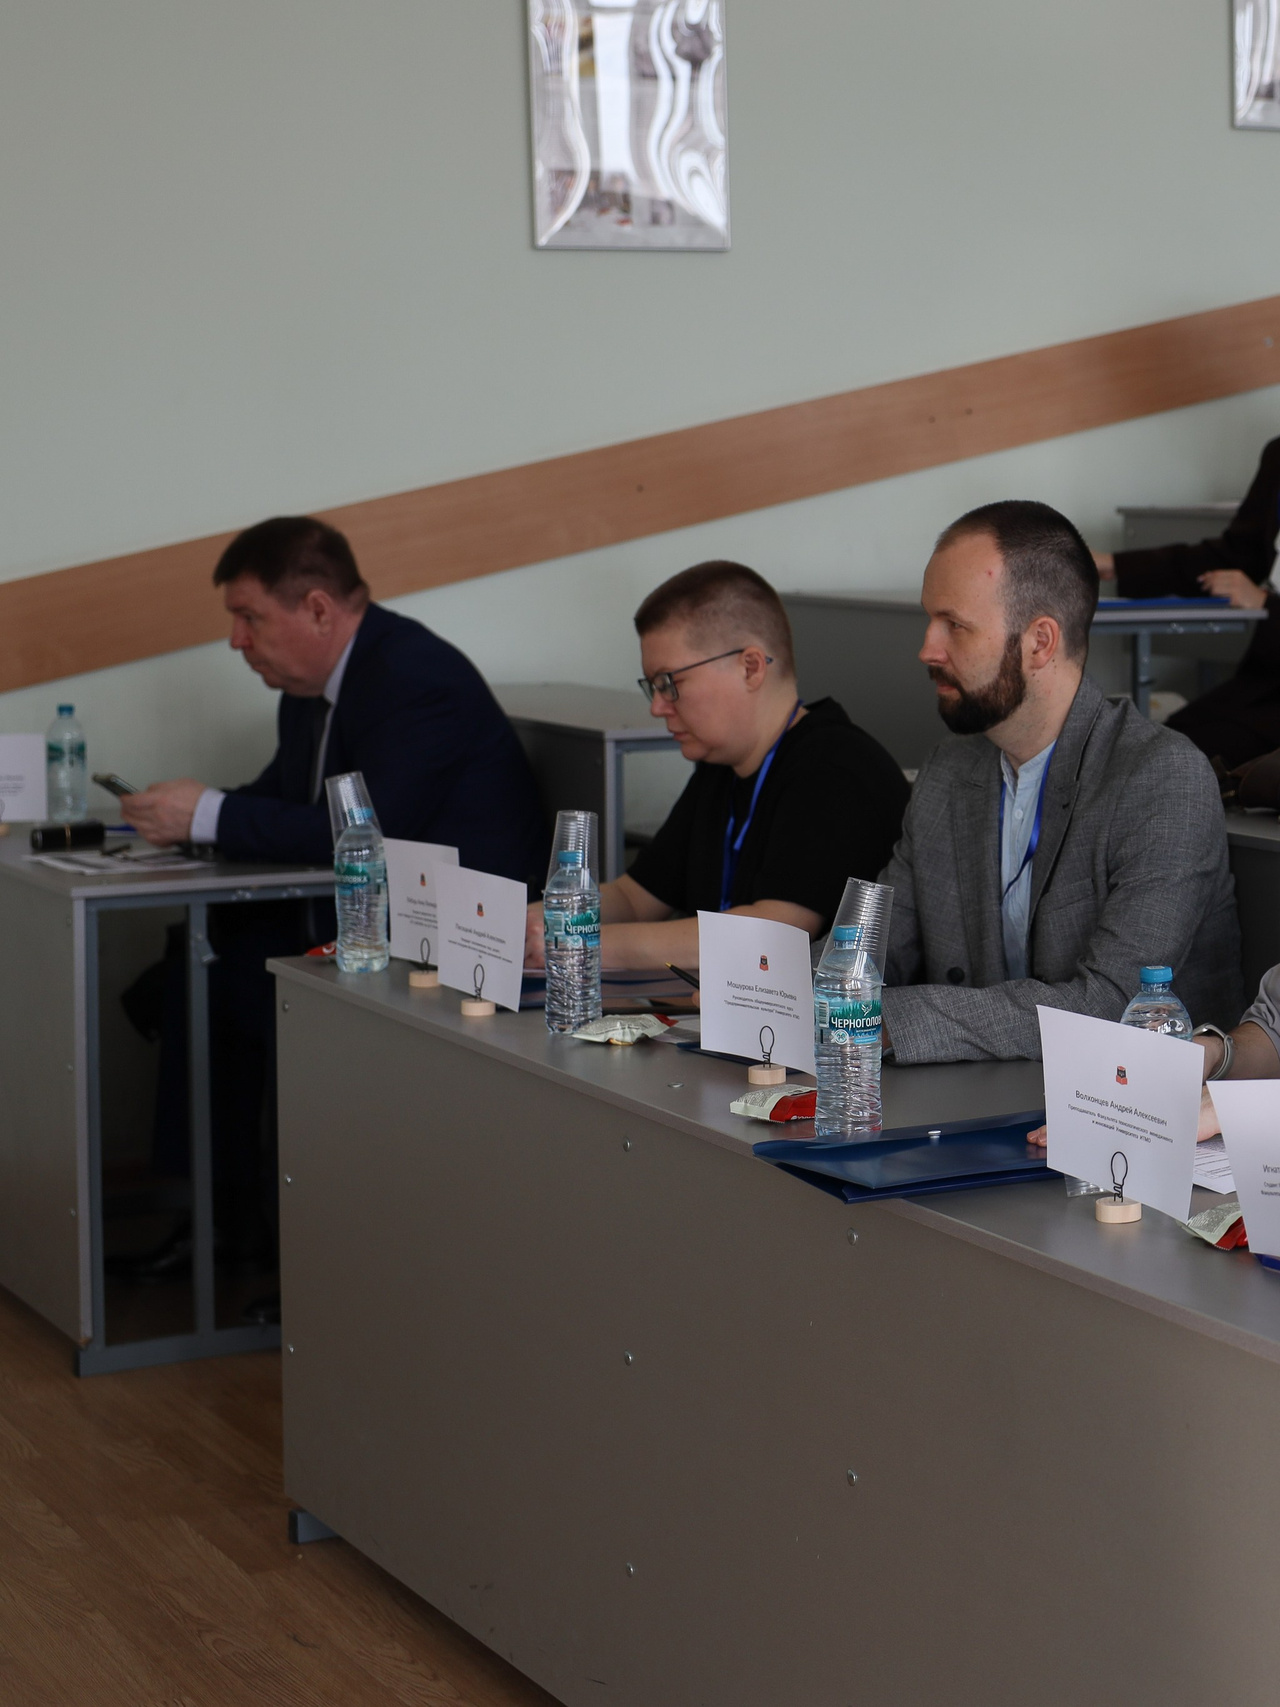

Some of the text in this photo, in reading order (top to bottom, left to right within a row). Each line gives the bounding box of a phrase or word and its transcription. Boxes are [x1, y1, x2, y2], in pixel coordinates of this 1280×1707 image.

[755, 985, 779, 997] Елизавета
[1075, 1090, 1167, 1127] Волхонцев Андрей Алексеевич
